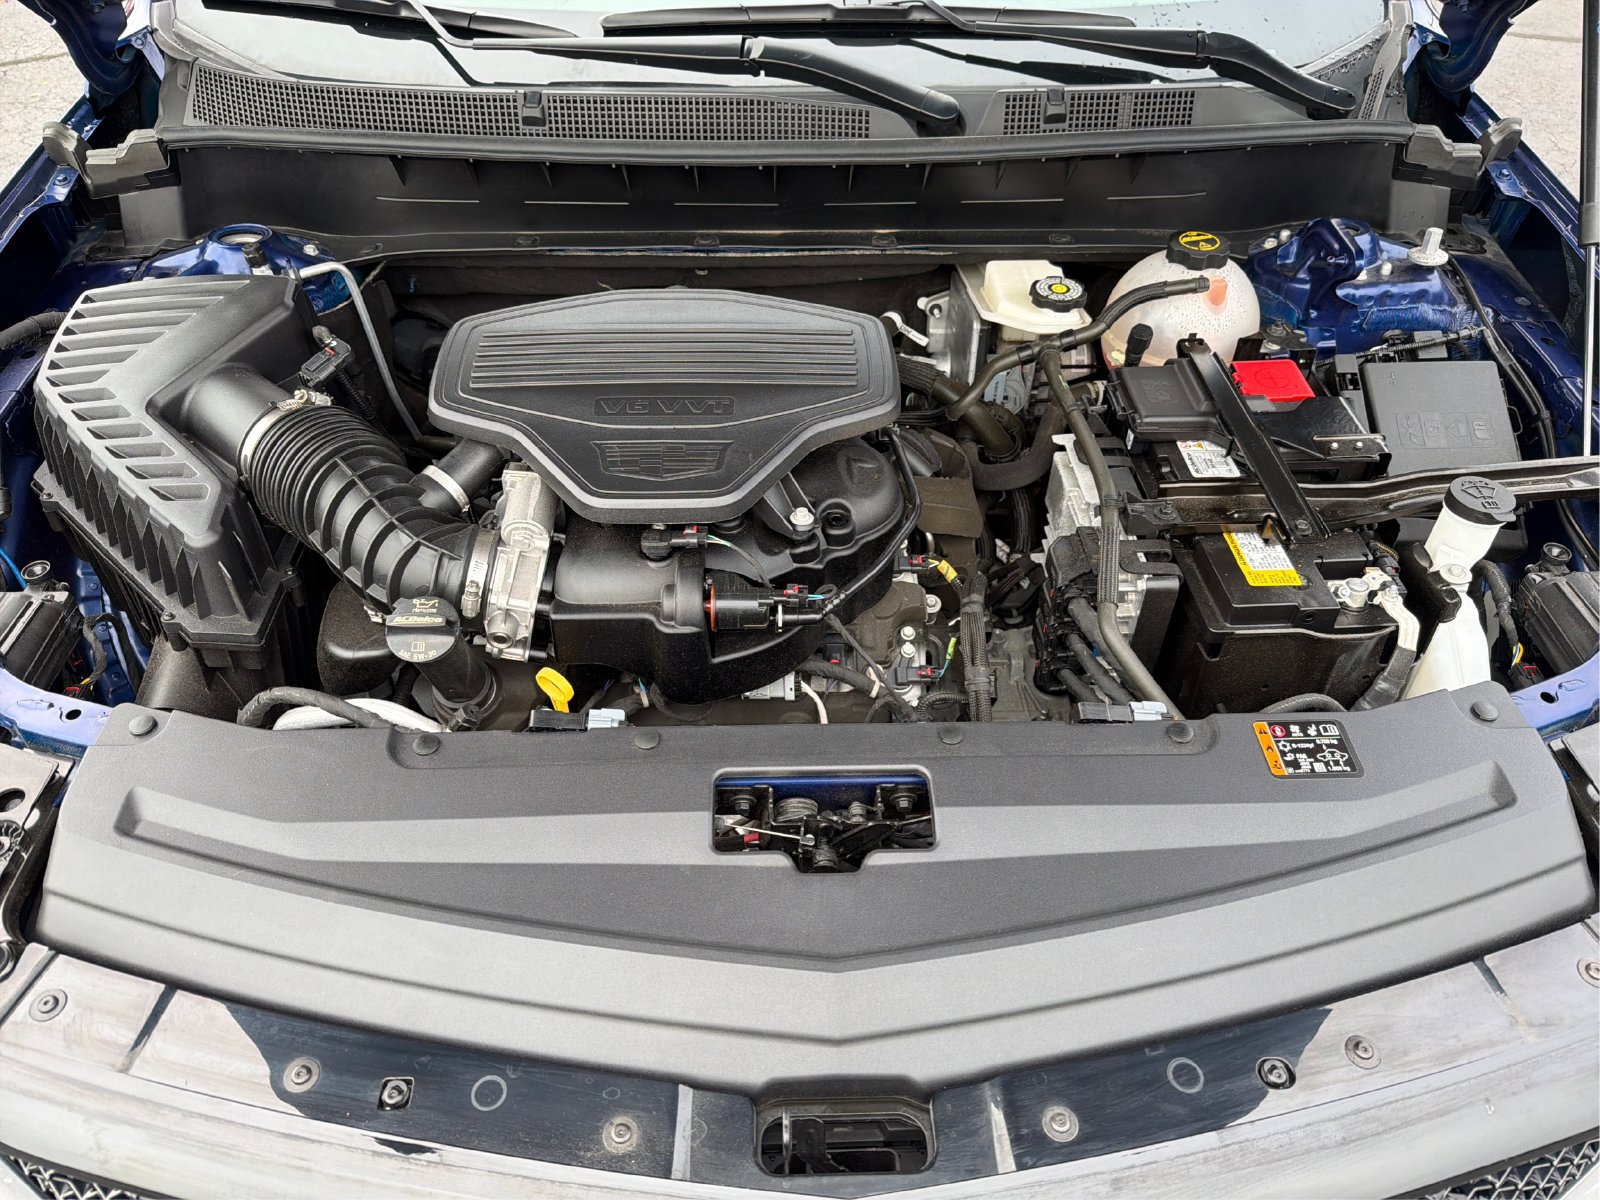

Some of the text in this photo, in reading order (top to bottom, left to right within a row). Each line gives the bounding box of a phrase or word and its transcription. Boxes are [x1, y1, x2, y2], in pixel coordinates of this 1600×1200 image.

[600, 399, 730, 414] V6 VVT
[399, 649, 437, 660] SAE 5W-30
